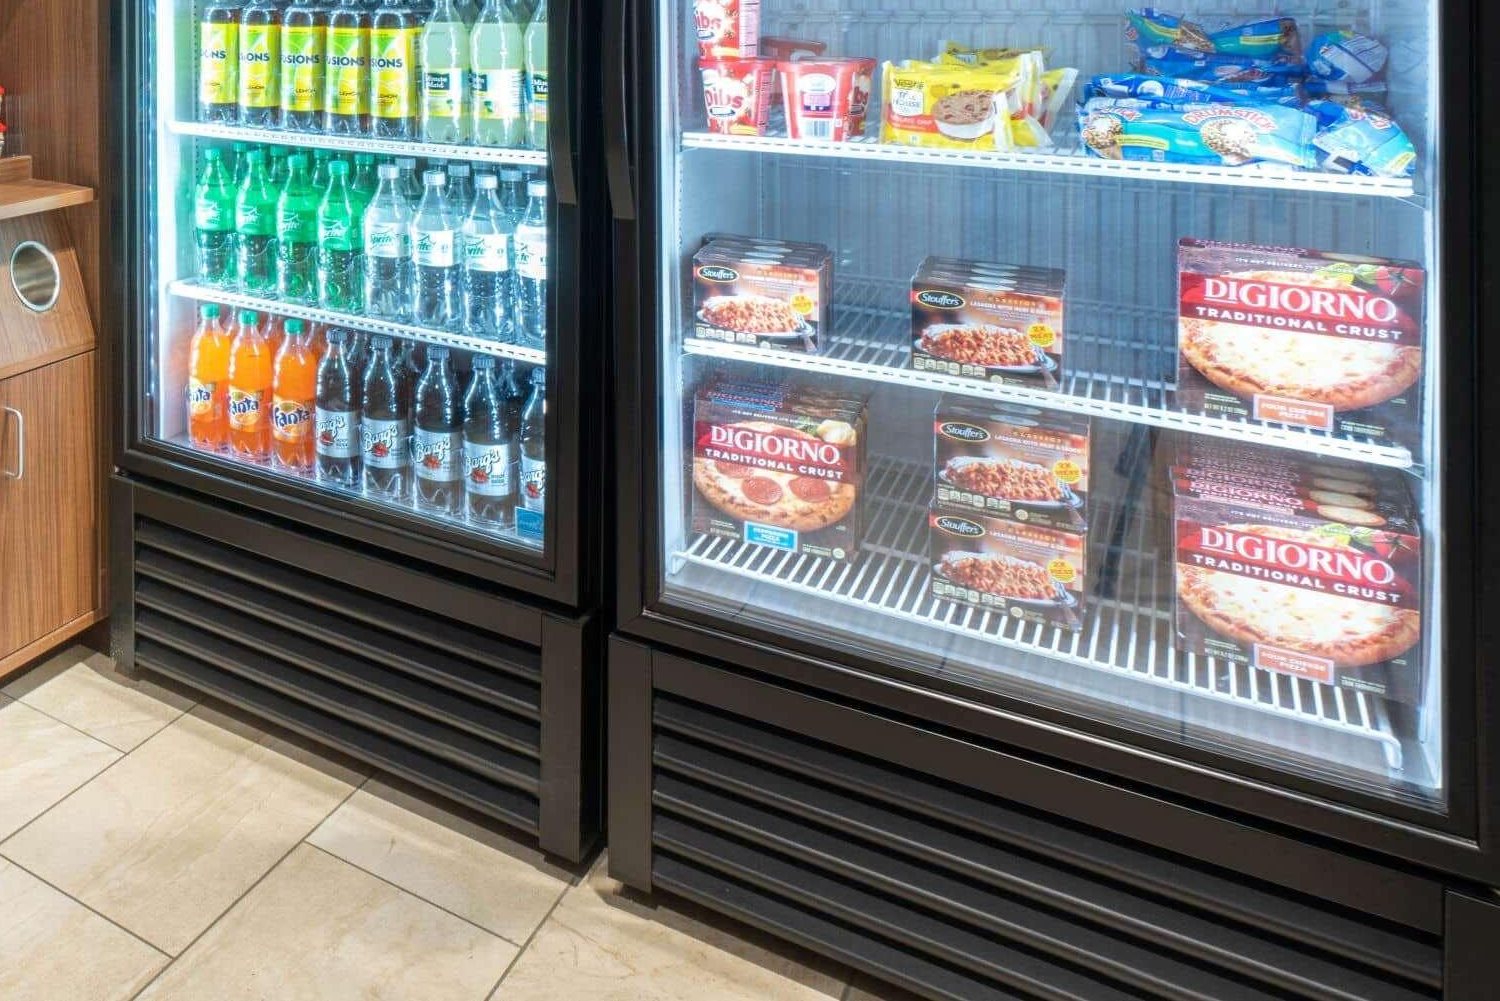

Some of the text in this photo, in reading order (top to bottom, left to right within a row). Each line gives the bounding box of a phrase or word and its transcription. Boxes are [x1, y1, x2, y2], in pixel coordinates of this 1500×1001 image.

[702, 269, 734, 280] Stouffer's
[921, 292, 960, 306] Stouffer's
[1195, 305, 1403, 340] TRADITIONAL CRUST
[945, 424, 984, 440] Stouffer's
[704, 448, 844, 480] TRADITIONAL CRUST
[941, 518, 979, 534] Stouffer's
[1193, 553, 1401, 604] TRADITIONAL CRUST
